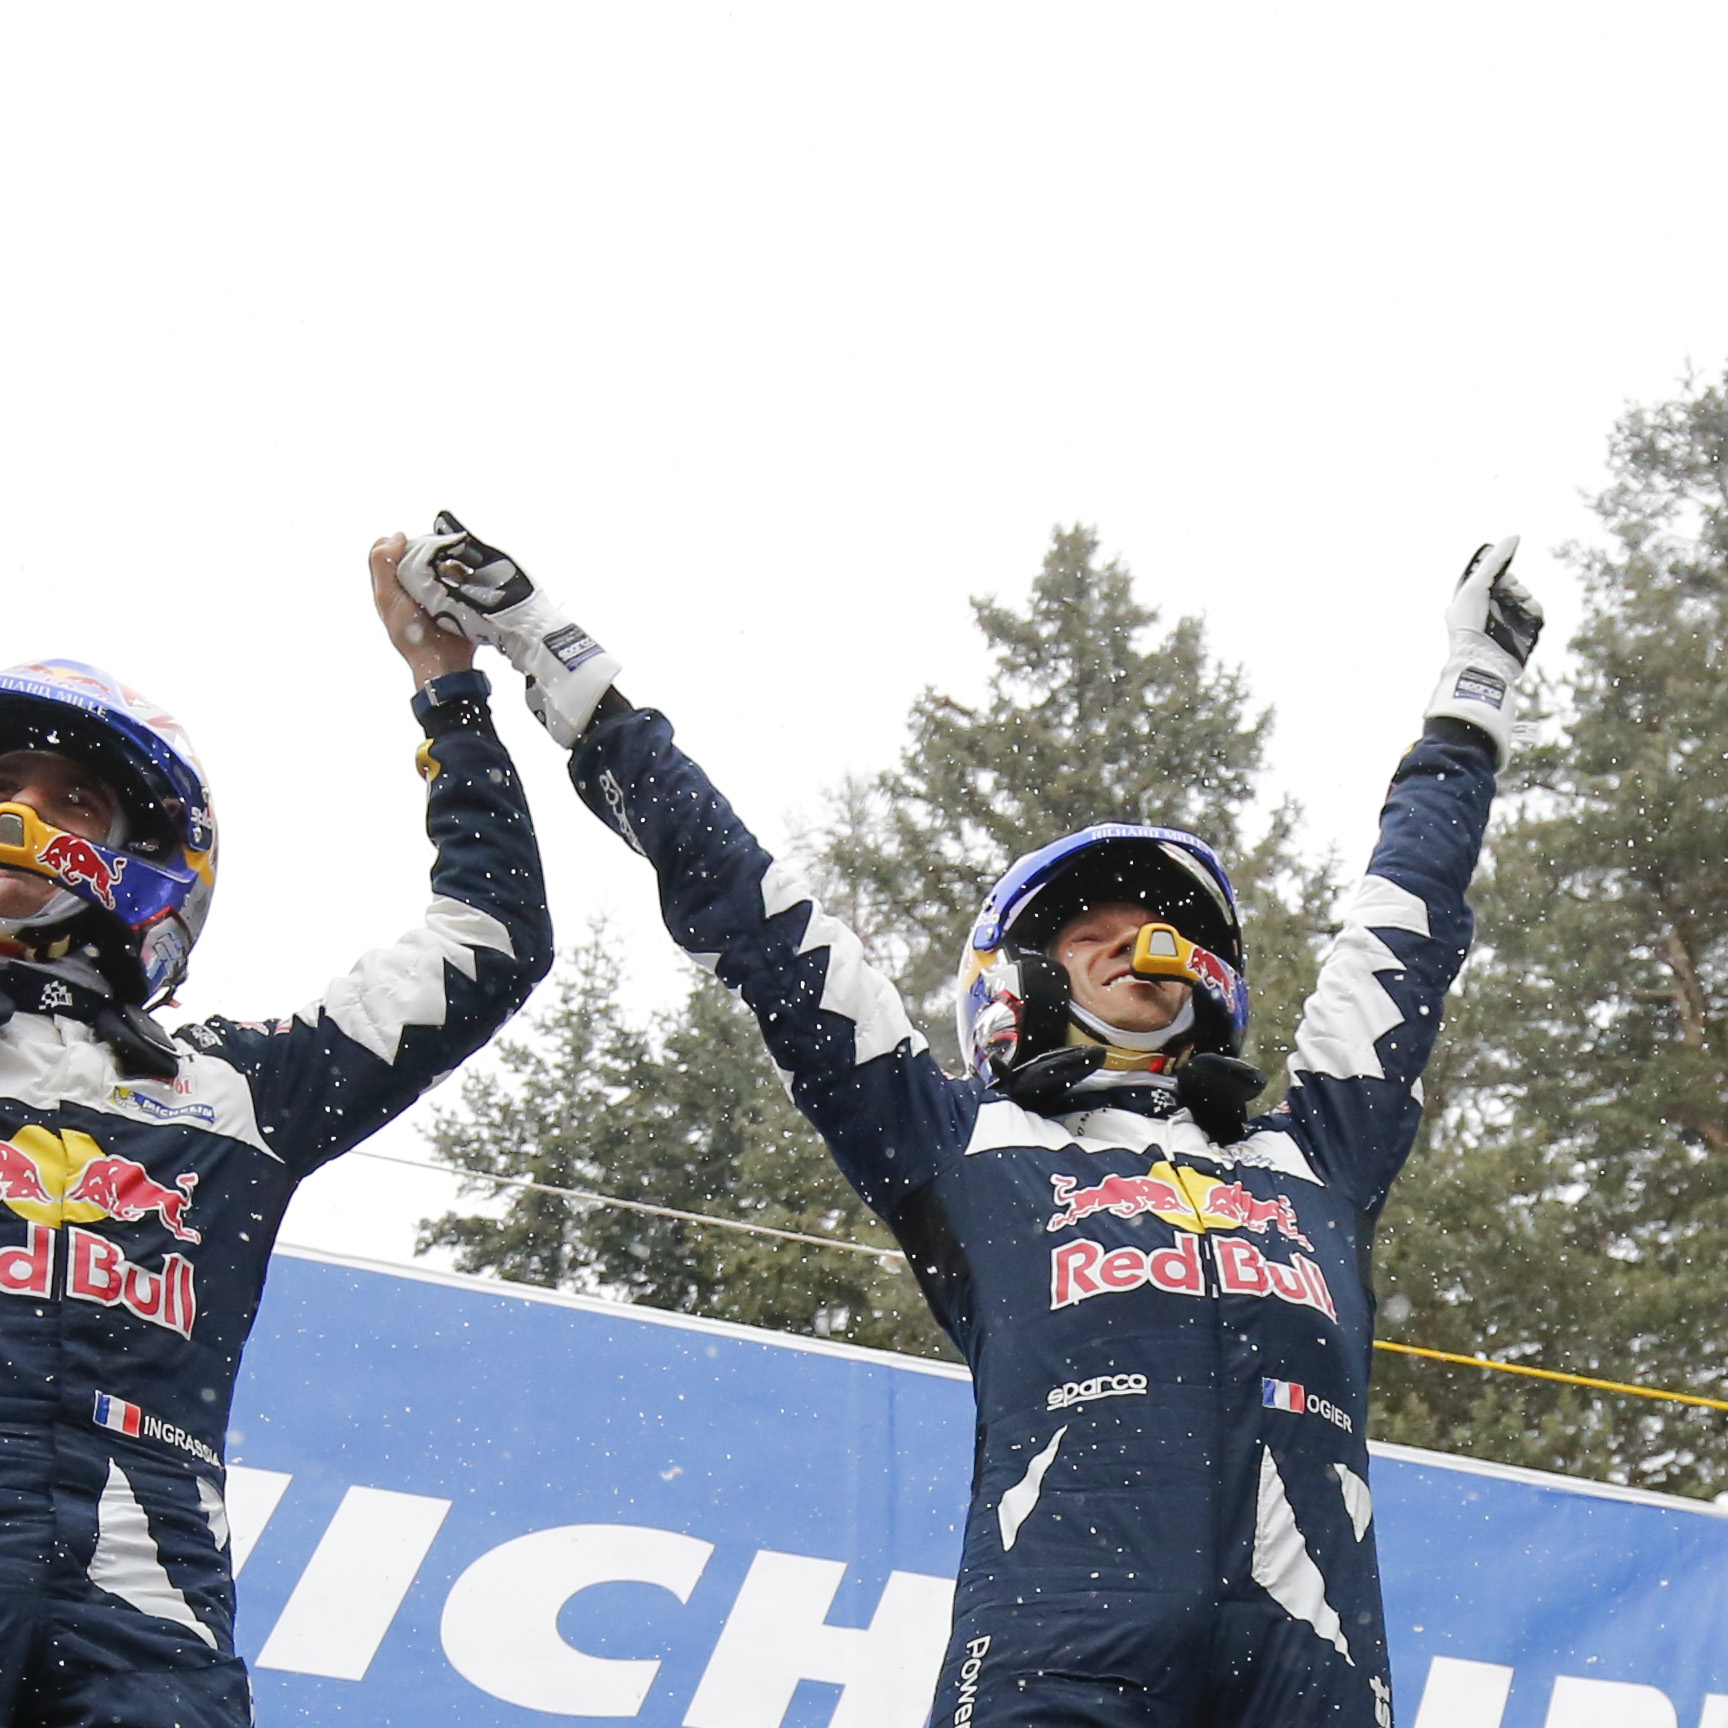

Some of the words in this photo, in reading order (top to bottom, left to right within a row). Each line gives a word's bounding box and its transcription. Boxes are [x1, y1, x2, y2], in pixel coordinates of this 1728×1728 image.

[66, 1227, 198, 1340] Bull
[1051, 1233, 1204, 1310] Red
[1212, 1235, 1338, 1323] Bull
[1047, 1374, 1147, 1409] sparco
[1306, 1394, 1353, 1433] OGIER
[143, 1415, 224, 1470] INGRASSIA
